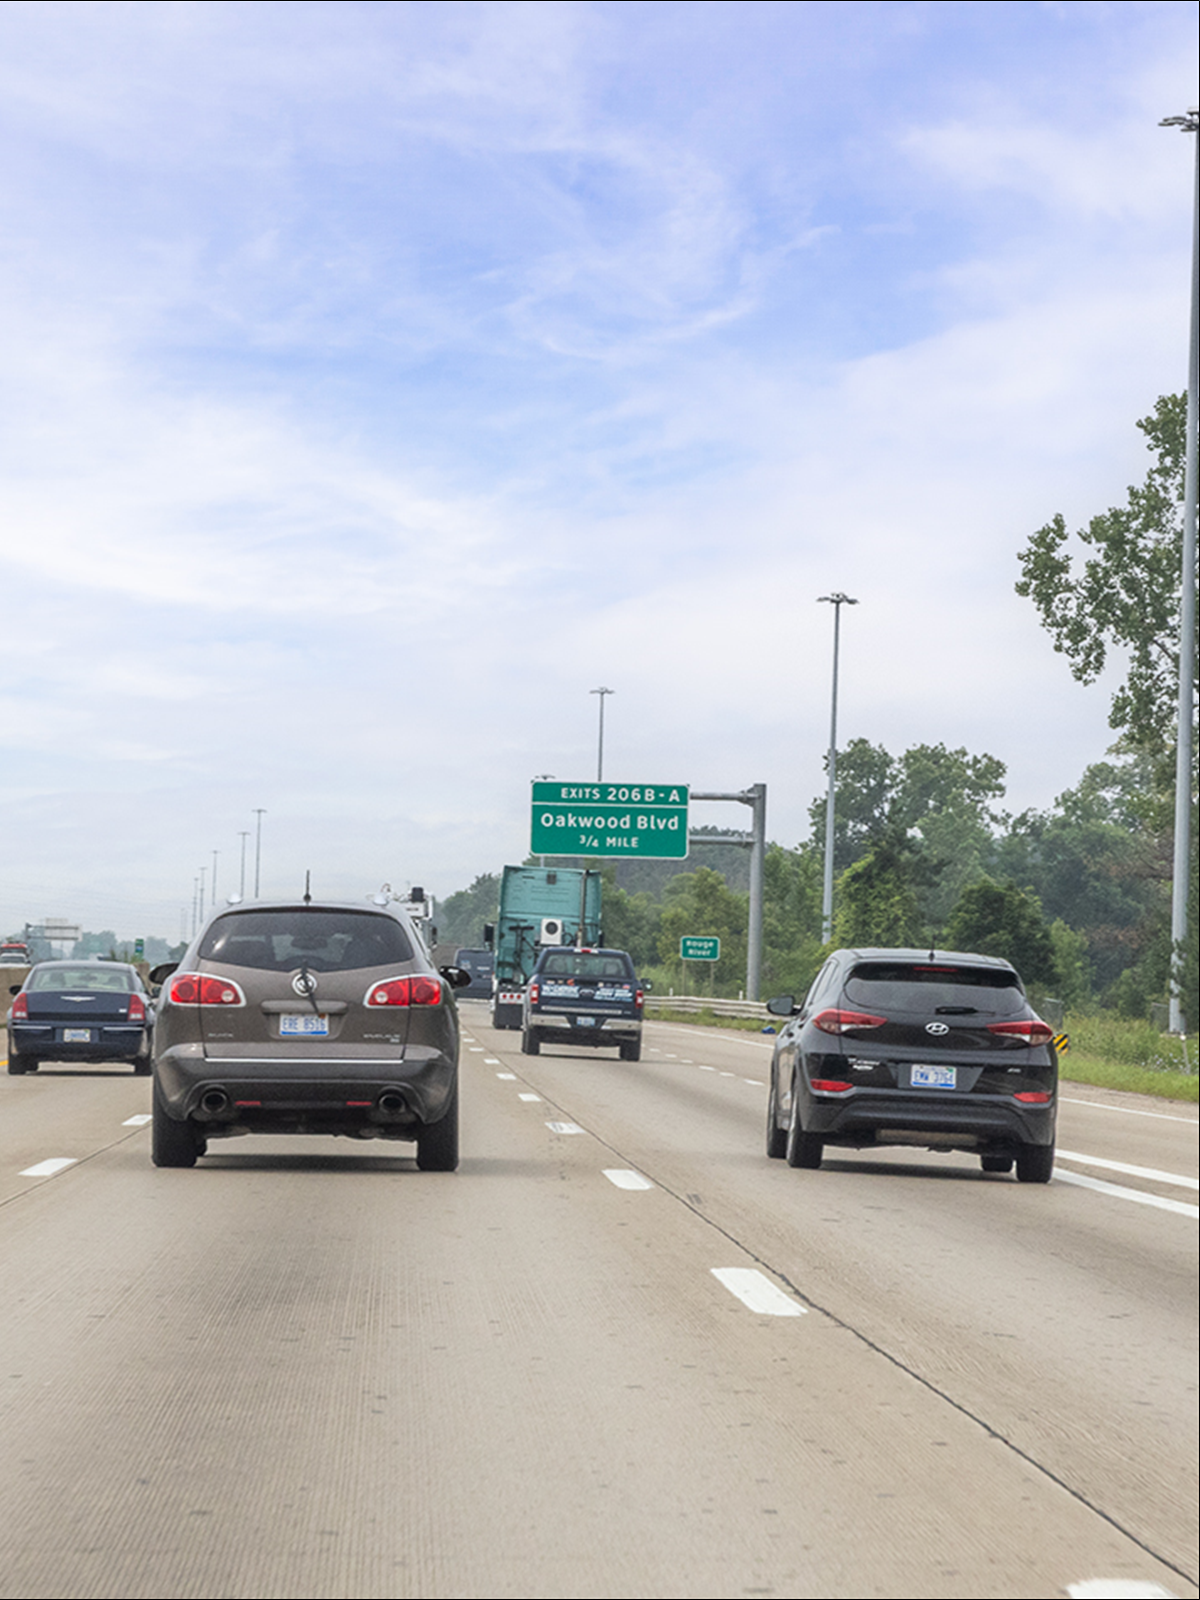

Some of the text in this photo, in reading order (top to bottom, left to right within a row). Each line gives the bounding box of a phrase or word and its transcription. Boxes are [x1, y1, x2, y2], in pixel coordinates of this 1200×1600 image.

[560, 787, 600, 800] EXITS
[540, 812, 679, 831] Oakwood Blvd
[578, 834, 640, 849] 3/4 MILE
[686, 940, 715, 950] Rouge
[688, 948, 712, 957] River
